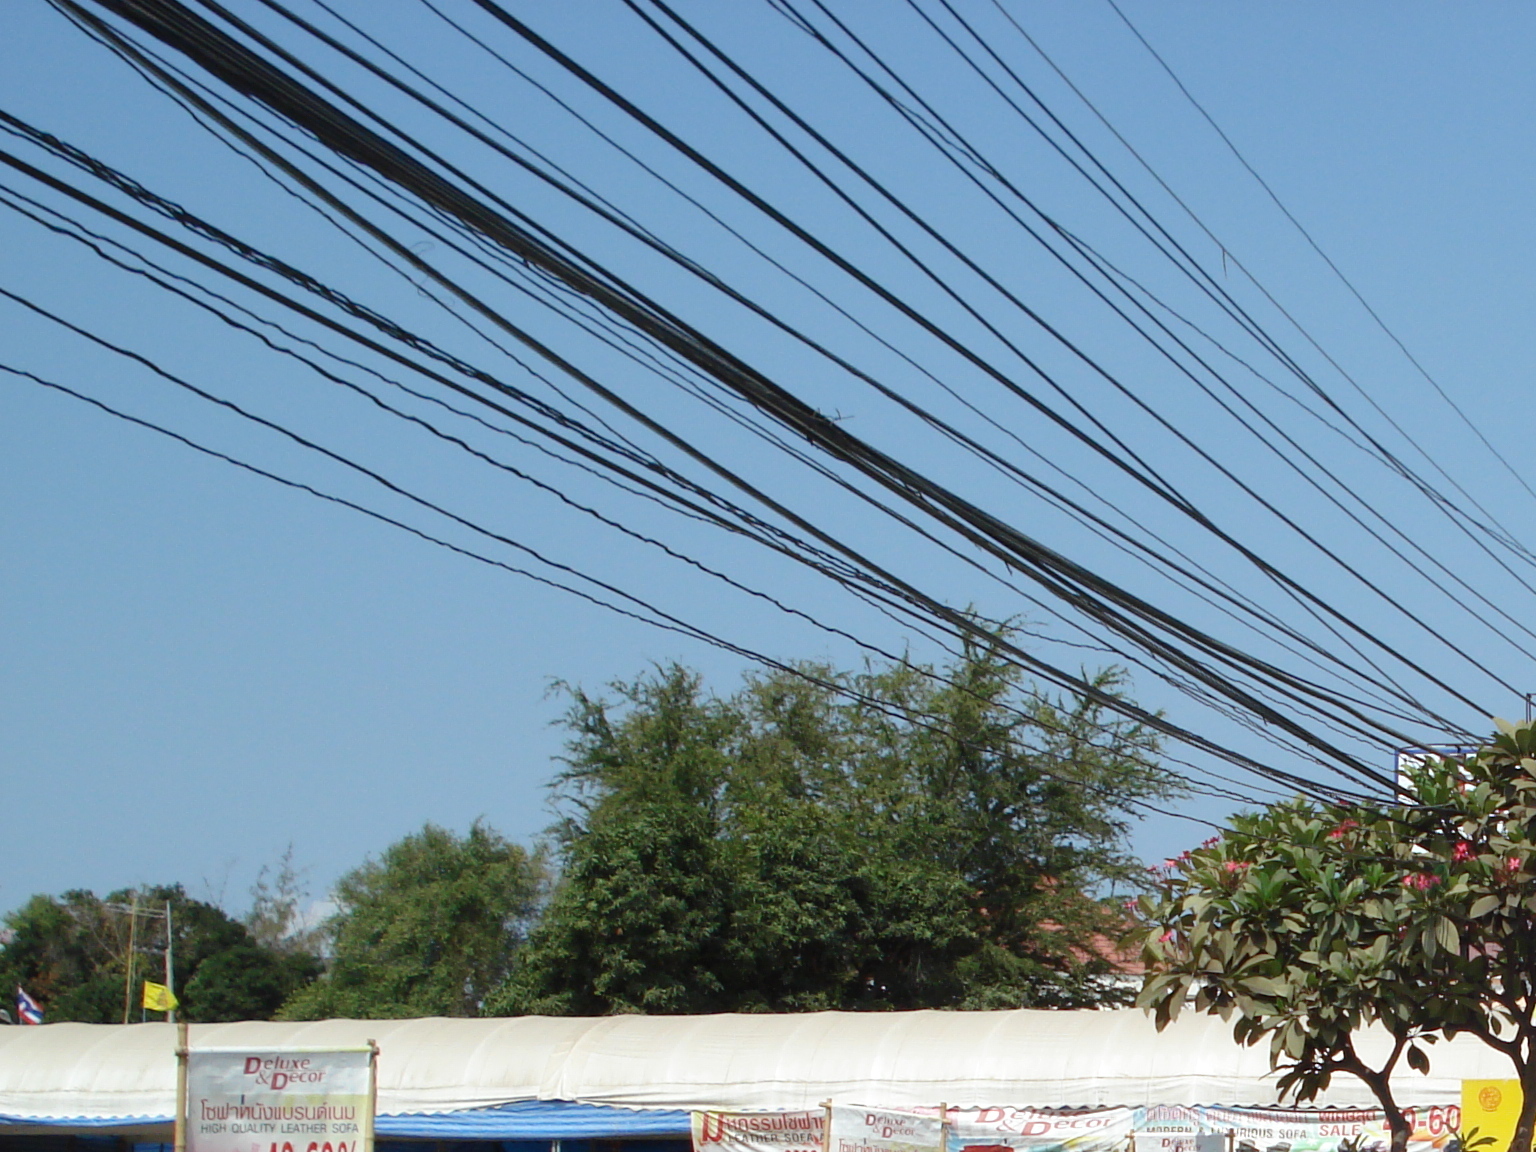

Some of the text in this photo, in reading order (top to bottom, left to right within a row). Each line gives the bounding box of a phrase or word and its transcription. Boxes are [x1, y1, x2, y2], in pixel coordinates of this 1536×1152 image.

[243, 1056, 311, 1075] Deluxe
[255, 1070, 326, 1090] & Decor
[865, 1113, 907, 1126] Deluxe
[1021, 1115, 1112, 1136] Decor
[201, 1123, 360, 1134] HIGH QUALITY LEATHER SOFA
[1278, 1129, 1307, 1139] SOFA
[1319, 1124, 1361, 1136] SALE
